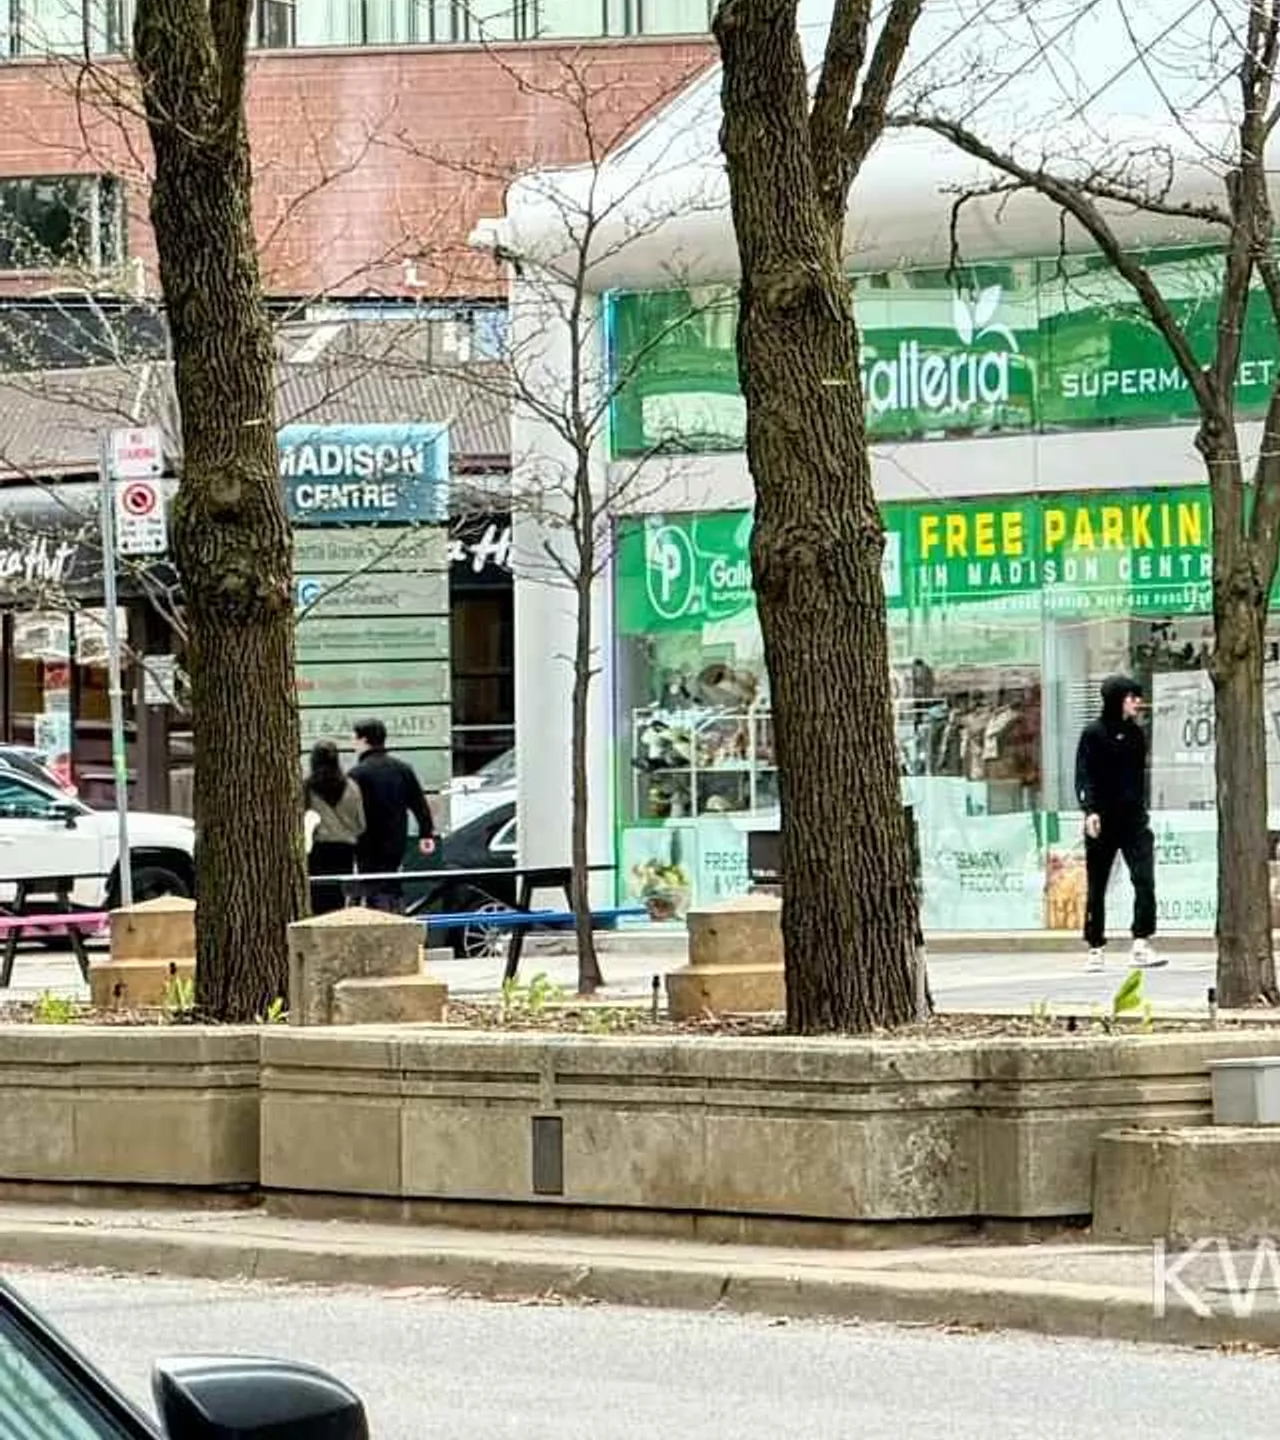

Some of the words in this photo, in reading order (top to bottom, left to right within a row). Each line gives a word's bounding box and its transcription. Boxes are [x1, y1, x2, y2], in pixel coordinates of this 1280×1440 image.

[860, 339, 1009, 411] alleria
[1061, 360, 1275, 398] SUPERMET
[296, 483, 398, 509] CENTRE
[920, 512, 1023, 559] FREE
[1045, 503, 1212, 553] PARKIN
[968, 558, 1098, 586] MADISON
[1119, 553, 1213, 579] CENTR
